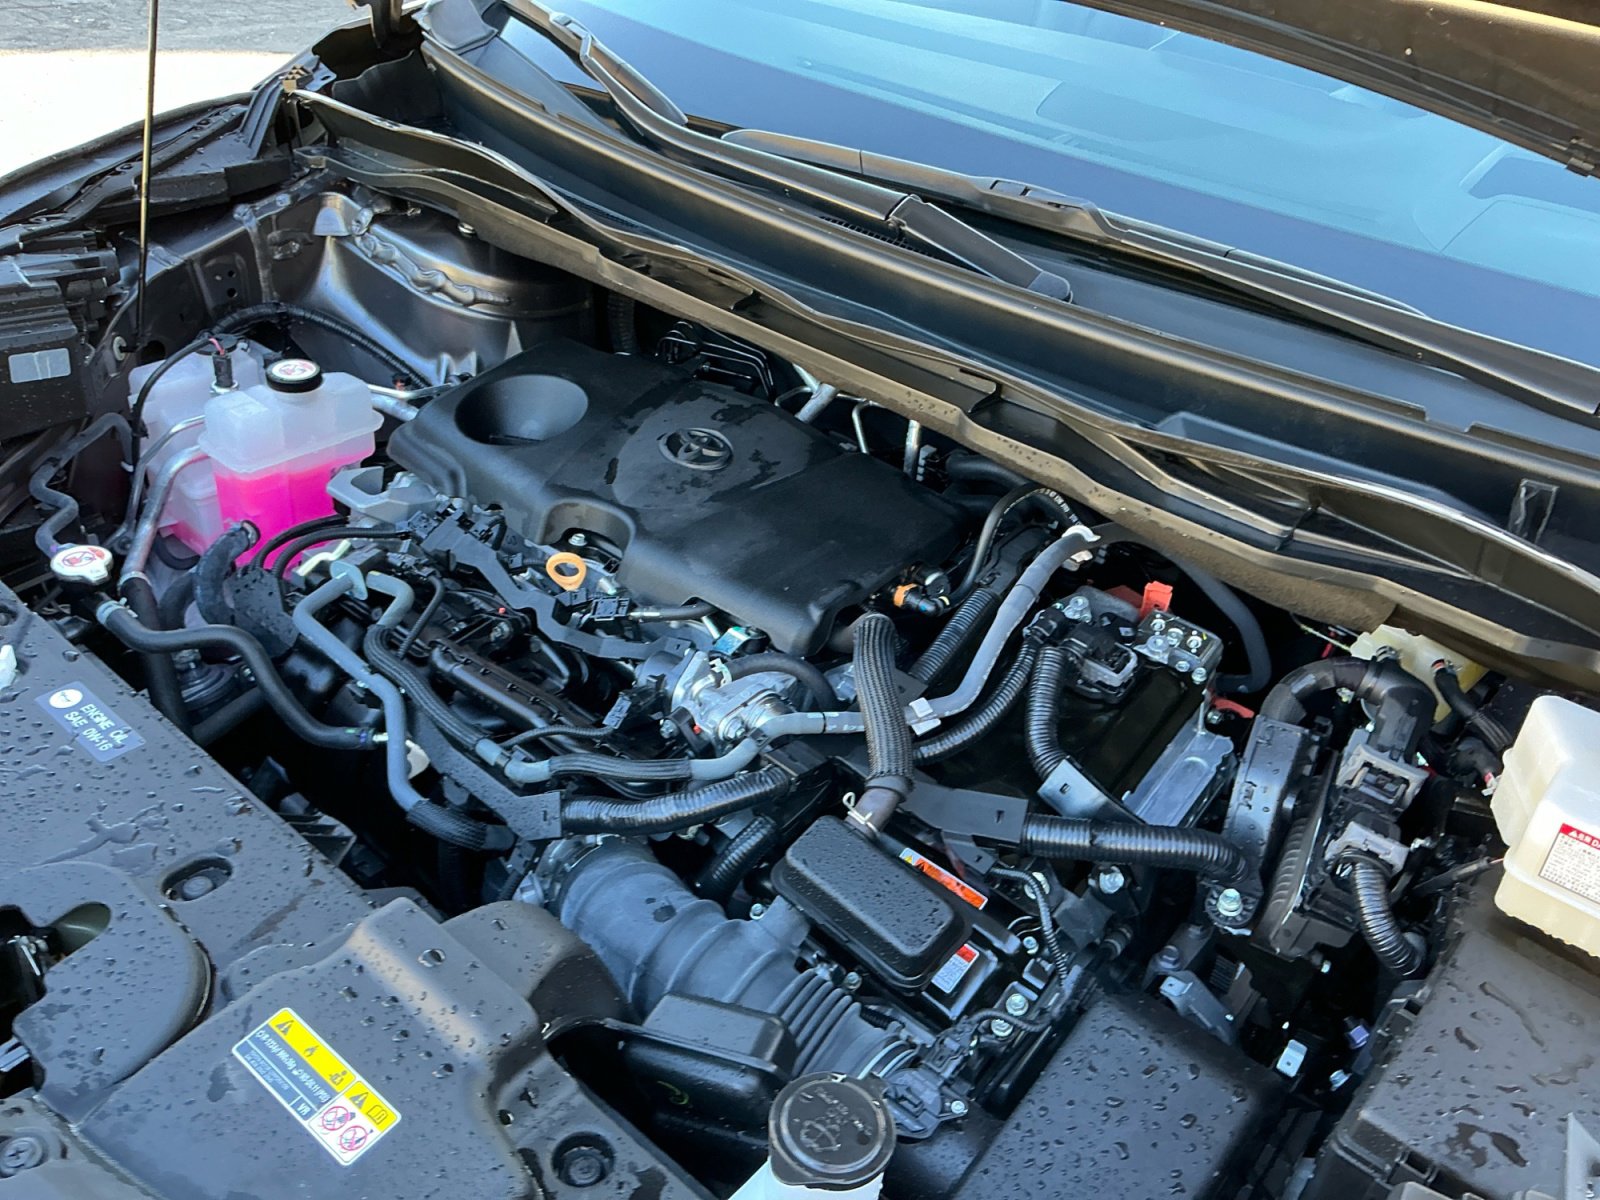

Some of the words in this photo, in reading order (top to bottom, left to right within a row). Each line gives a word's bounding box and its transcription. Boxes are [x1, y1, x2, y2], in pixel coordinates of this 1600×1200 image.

[64, 711, 89, 728] SAE
[82, 727, 113, 751] 0W-16
[80, 703, 115, 730] ENGINE
[109, 729, 128, 744] OIL
